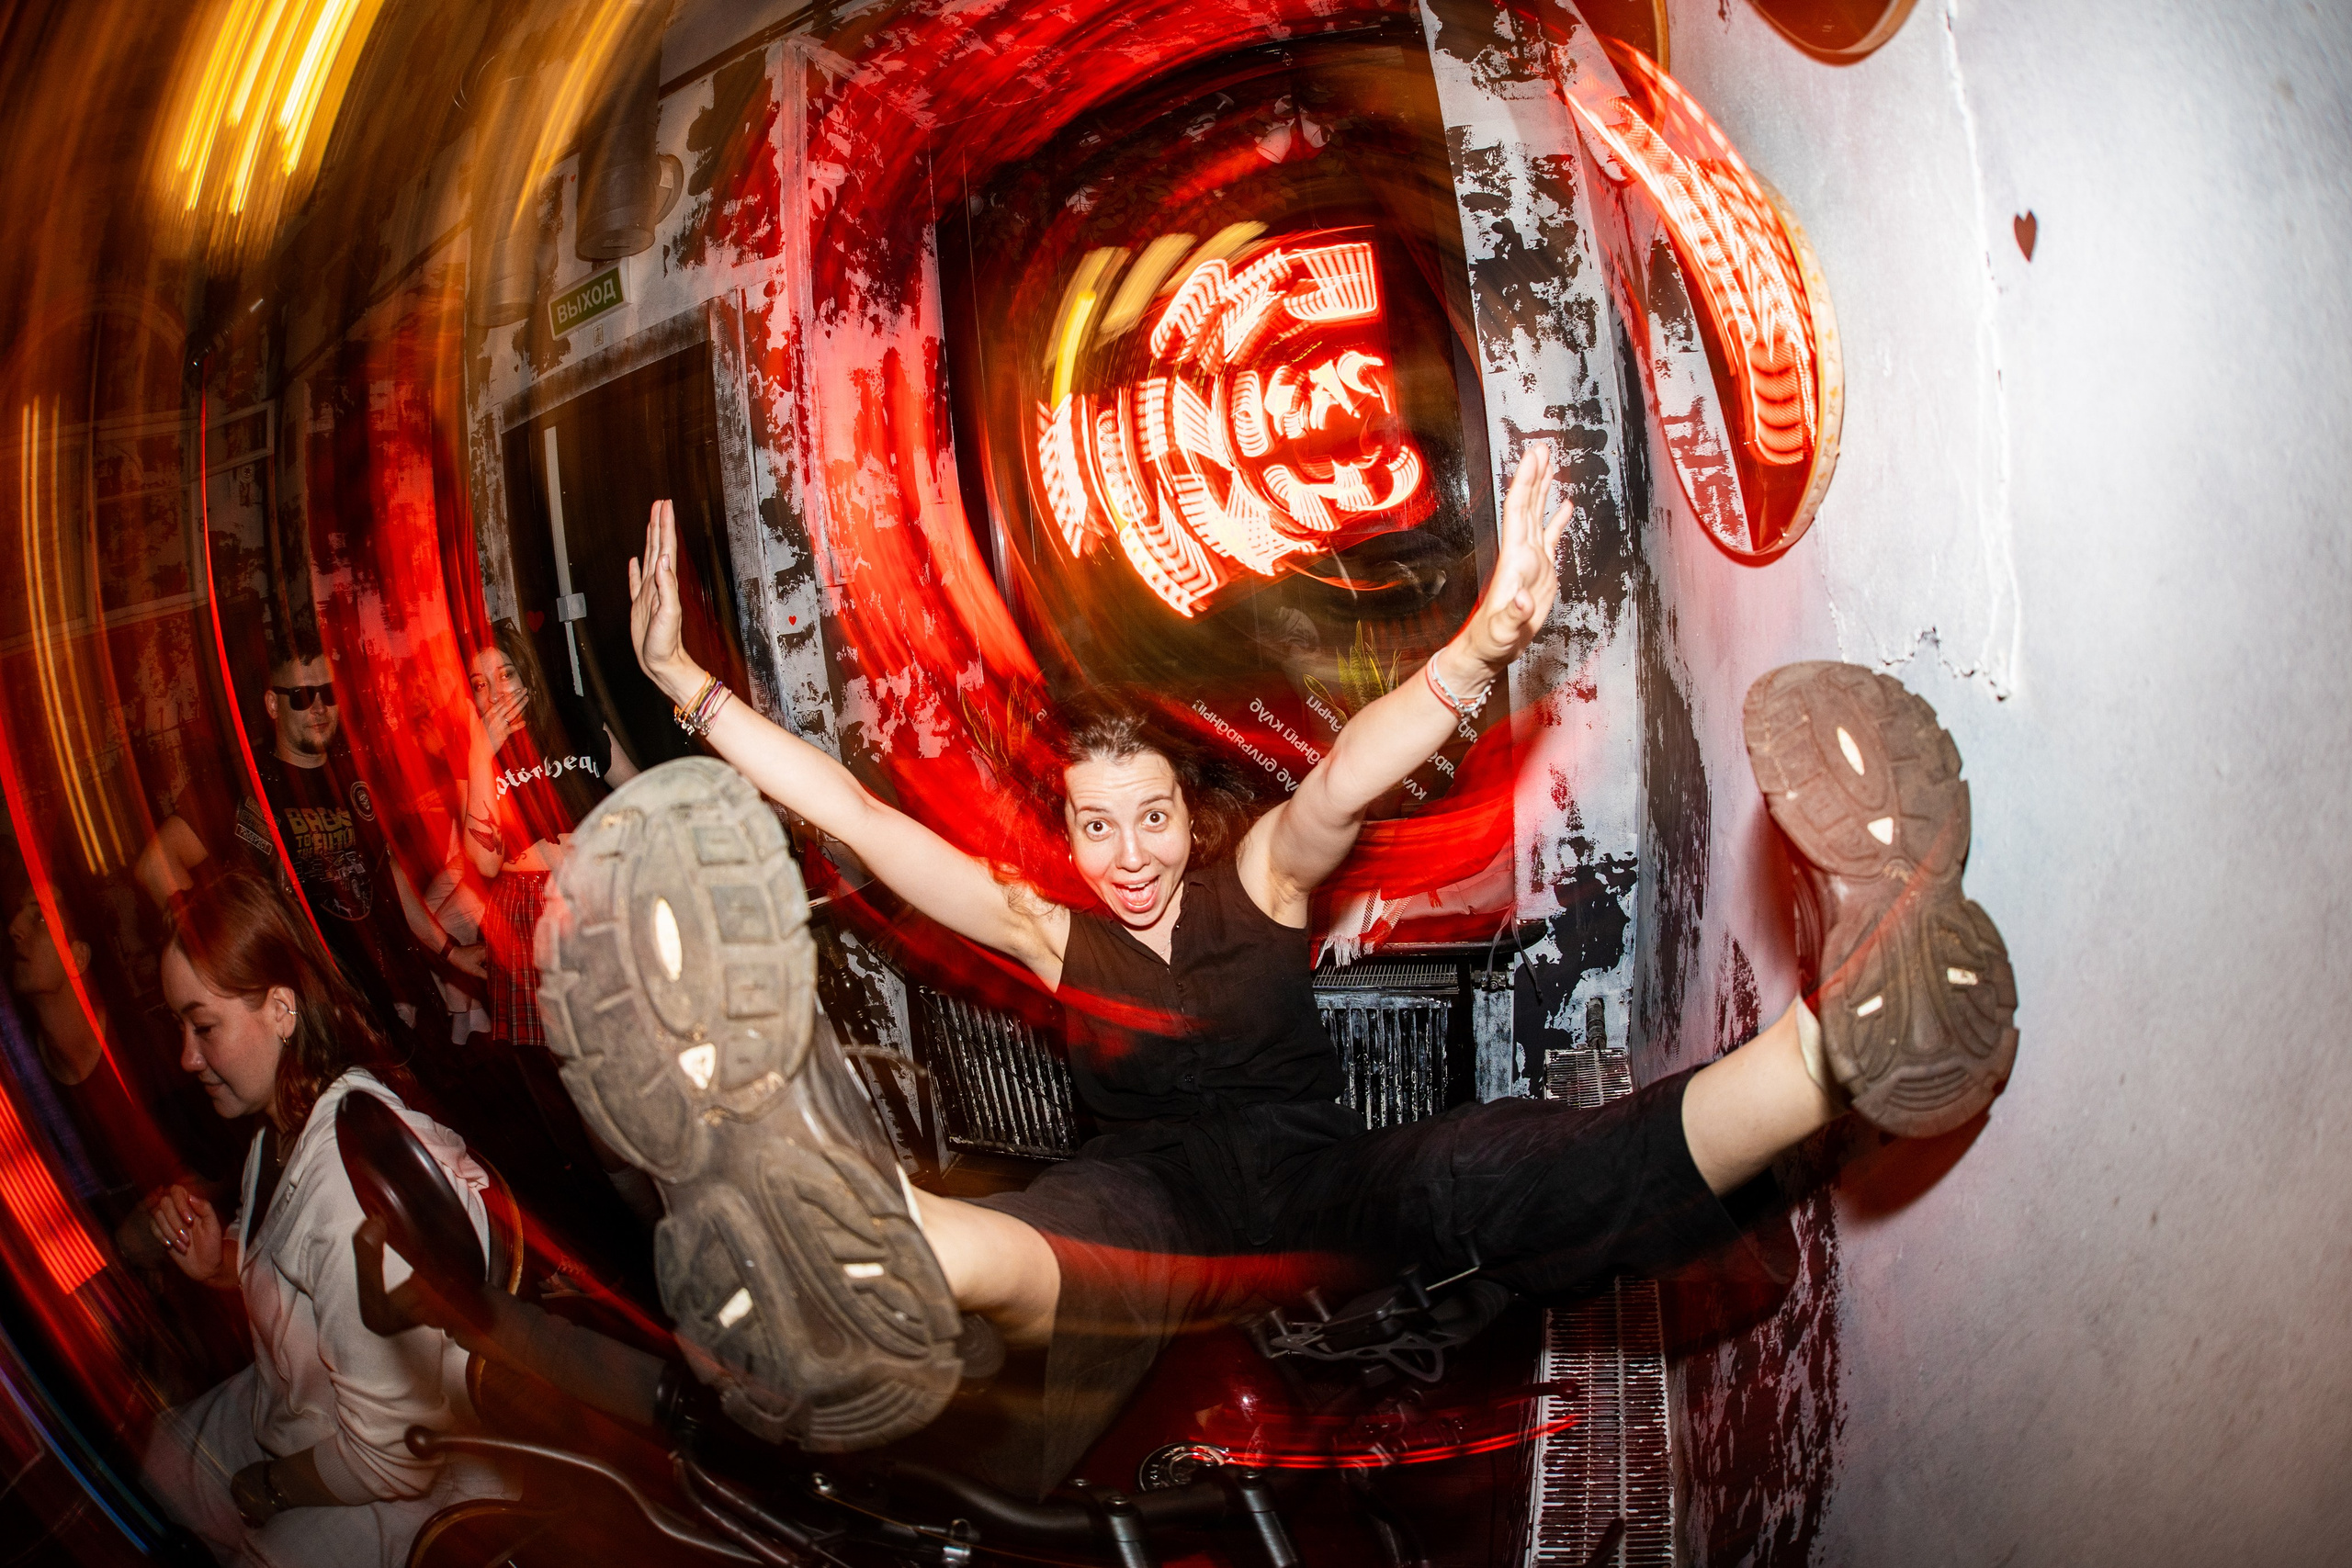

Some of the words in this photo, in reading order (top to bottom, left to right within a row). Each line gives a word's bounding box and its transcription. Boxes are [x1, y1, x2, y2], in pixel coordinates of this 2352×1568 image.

[557, 278, 616, 324] ВЫХОД
[295, 834, 311, 848] TO
[311, 828, 356, 854] FUTU
